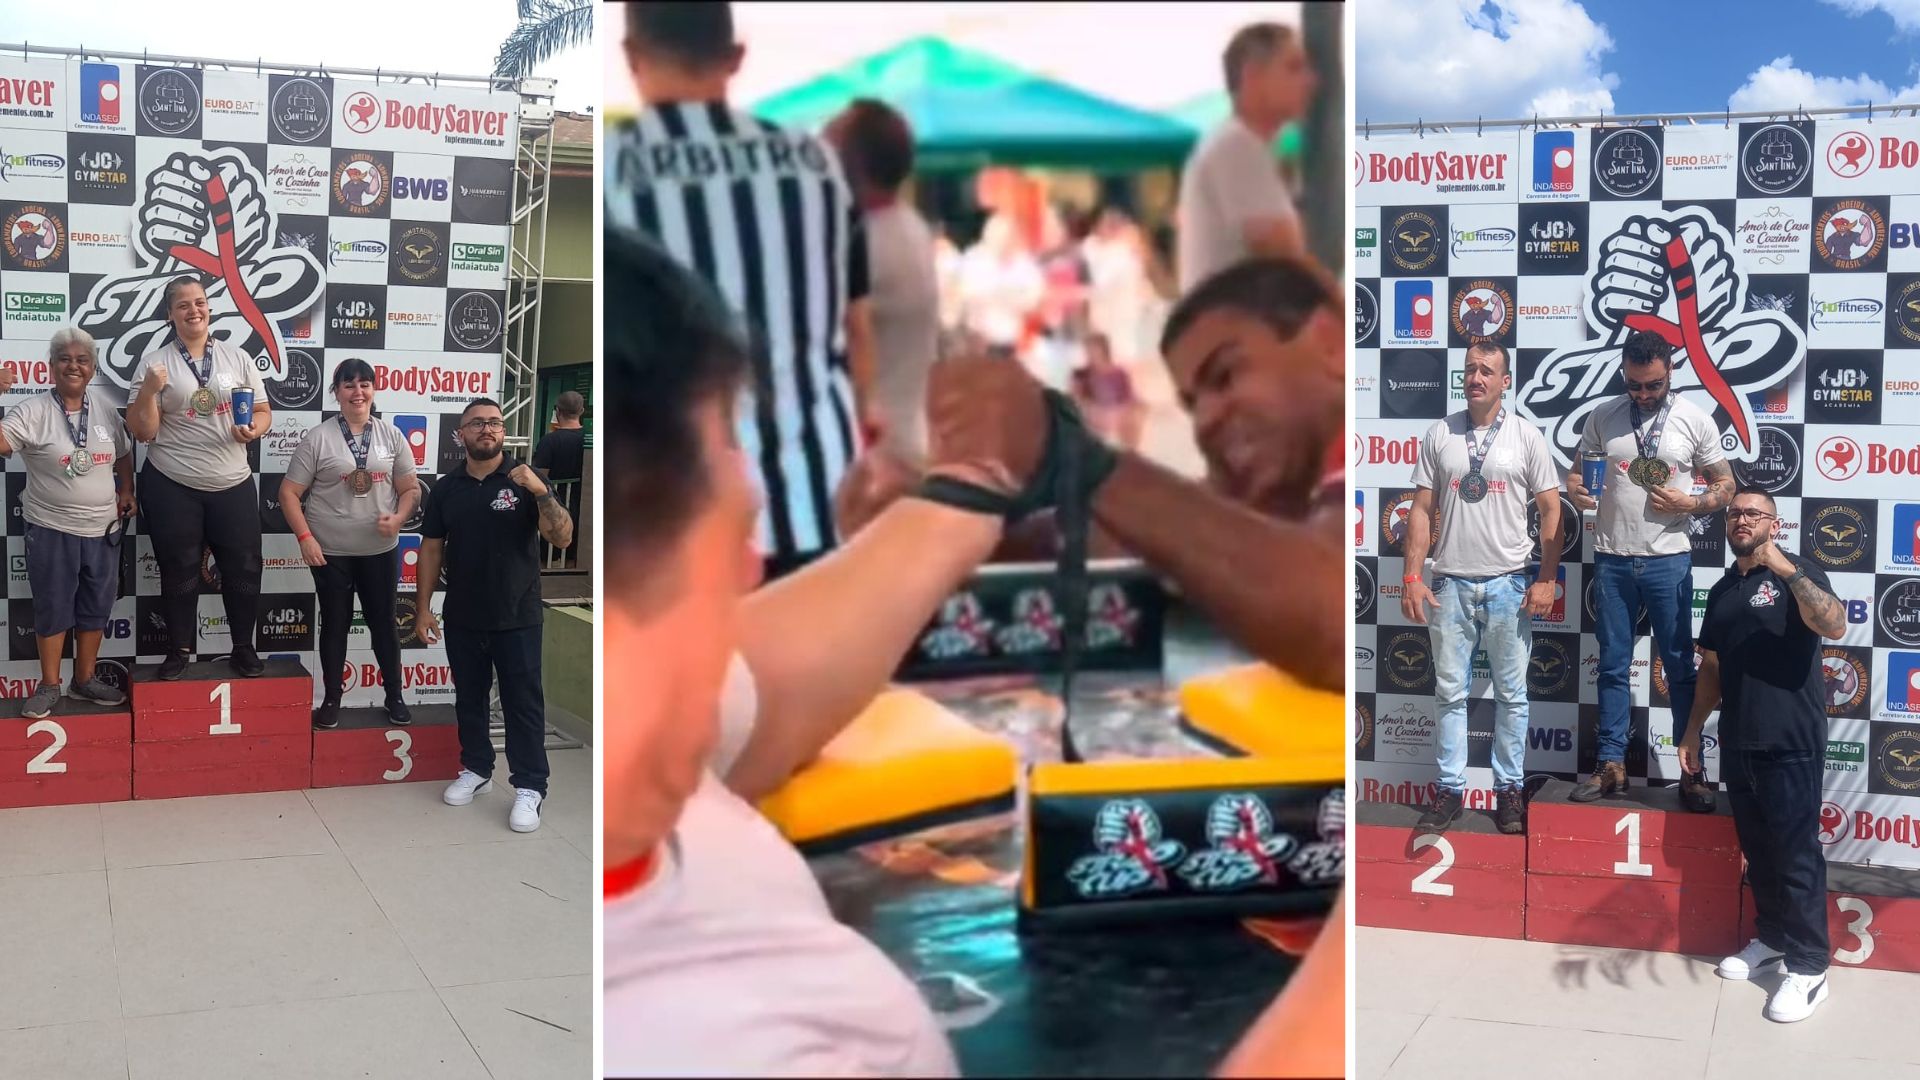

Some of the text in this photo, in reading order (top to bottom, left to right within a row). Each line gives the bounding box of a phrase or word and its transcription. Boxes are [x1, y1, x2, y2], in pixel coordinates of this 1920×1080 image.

[204, 98, 255, 110] EURO BAT
[82, 113, 119, 123] INDASEG
[384, 99, 508, 136] BodySaver
[89, 151, 112, 169] JC
[1665, 154, 1721, 165] EURO BAT
[268, 165, 328, 178] Amor de Casa
[1369, 151, 1507, 185] BodySaver
[74, 169, 127, 184] GYMSTAR
[285, 175, 320, 188] Cozinha
[393, 176, 448, 201] BWB
[1436, 183, 1505, 193] Suplementos.com.br
[1534, 182, 1572, 190] INDASEG
[1541, 221, 1564, 239] JC
[1737, 219, 1810, 233] Amor de Casa
[71, 232, 121, 243] EURO BAT
[1746, 231, 1799, 244] & Cozinha
[467, 245, 501, 256] Oral Sin
[1525, 241, 1580, 253] GYMSTAR
[451, 262, 500, 272] Indaiatuba
[22, 295, 62, 305] Oral Sin
[345, 301, 365, 317] JC
[1519, 306, 1572, 315] EURO BAT
[5, 312, 61, 322] Indaiatuba
[388, 313, 413, 321] EURO
[332, 318, 378, 329] GYMSTAR
[374, 365, 491, 395] BodySaver
[1830, 369, 1856, 387] JC
[1885, 381, 1919, 390] EURO
[1813, 389, 1872, 401] GYMSTAR
[262, 429, 286, 440] Amor
[276, 608, 295, 623] JC
[262, 625, 308, 635] GYMSTAR
[208, 682, 242, 735] 1
[1377, 714, 1403, 725] Amor
[1405, 716, 1416, 725] de
[1385, 726, 1431, 737] & Cozinha
[1527, 727, 1573, 752] WB
[26, 720, 69, 774] 2
[1842, 744, 1860, 754] Sin
[382, 730, 413, 781] 3
[1613, 812, 1653, 876] 1
[1411, 833, 1455, 897] 2
[1833, 896, 1874, 964] 3
